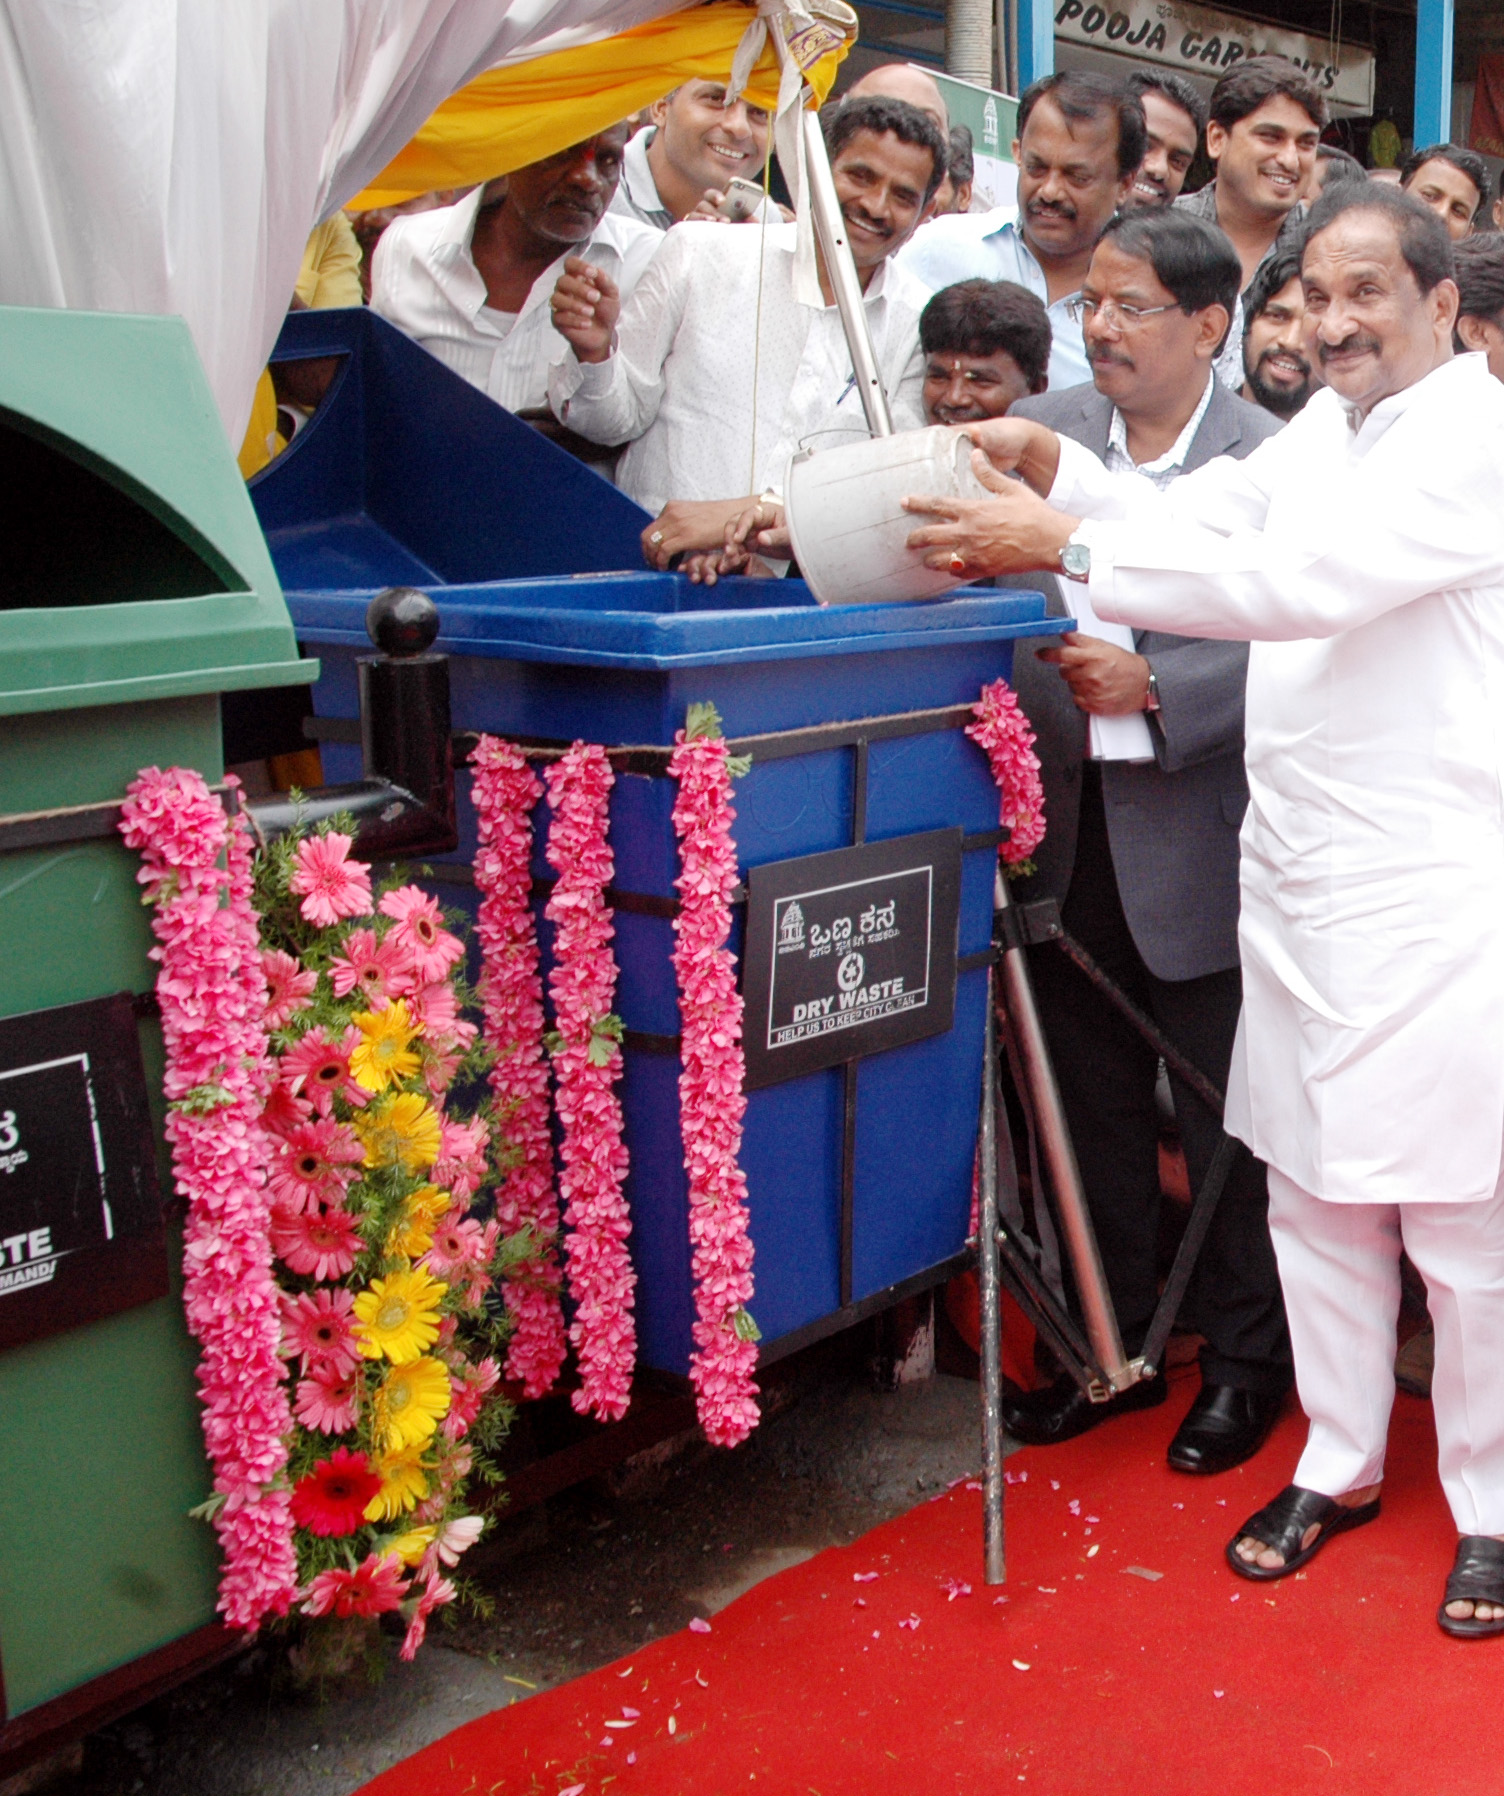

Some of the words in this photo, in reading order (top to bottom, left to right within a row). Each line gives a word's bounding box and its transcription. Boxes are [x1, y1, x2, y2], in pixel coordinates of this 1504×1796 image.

[1054, 0, 1167, 52] POOJA
[1180, 31, 1339, 89] GARTS
[810, 917, 853, 947] ಒಣ
[859, 899, 896, 934] ಕಸ
[777, 1025, 805, 1044] HELP
[806, 1021, 820, 1035] US
[822, 1016, 836, 1031] TO
[863, 1003, 885, 1020] CITY
[885, 994, 916, 1012] CEAN
[793, 995, 835, 1023] DRY
[838, 976, 904, 1010] WASTE
